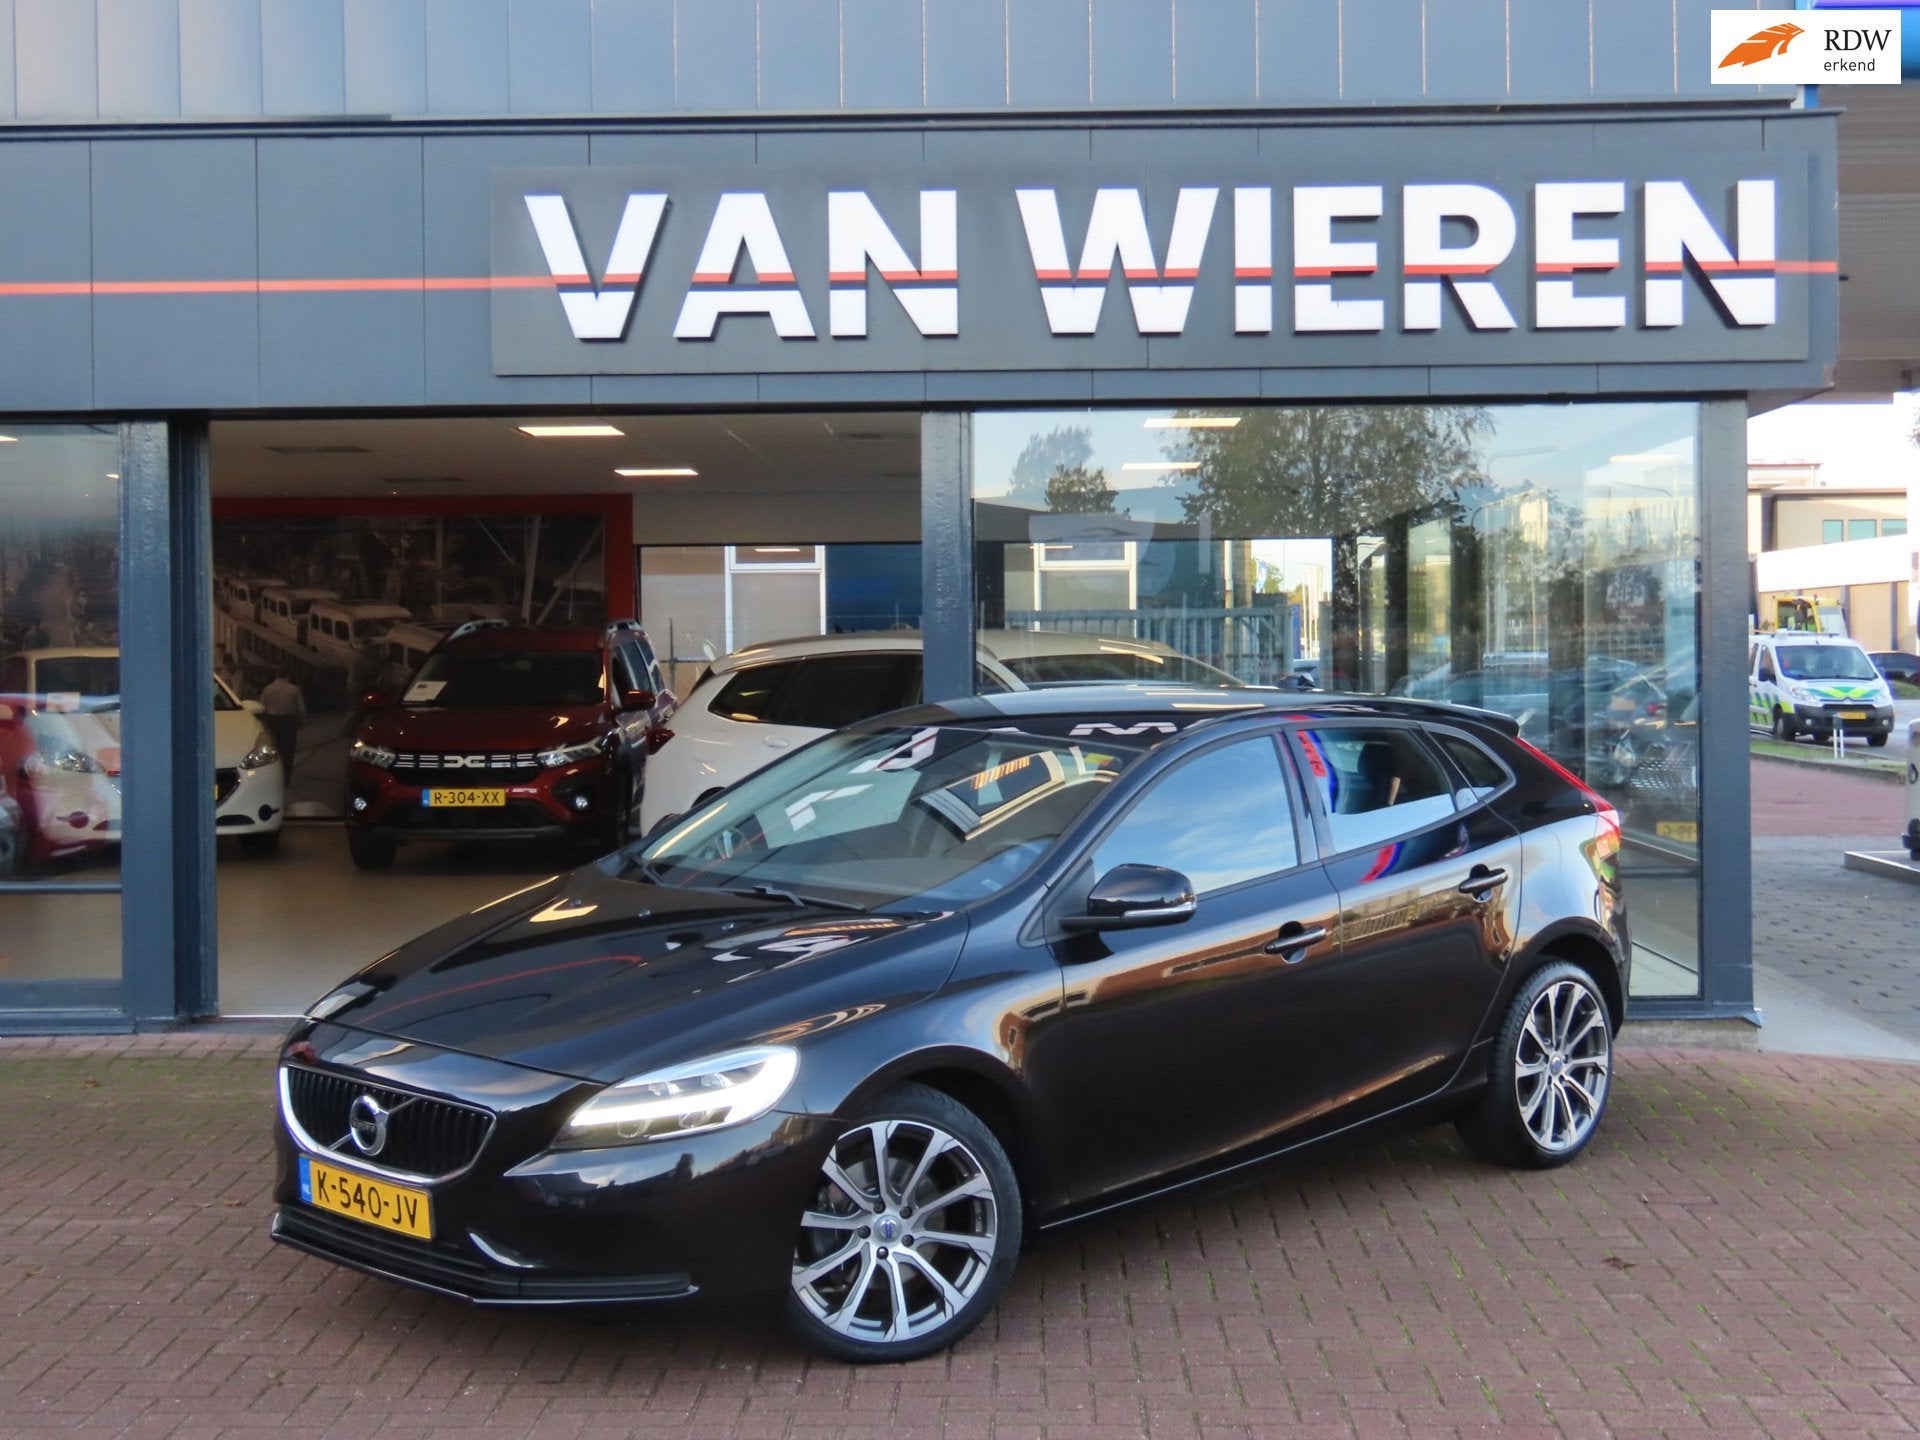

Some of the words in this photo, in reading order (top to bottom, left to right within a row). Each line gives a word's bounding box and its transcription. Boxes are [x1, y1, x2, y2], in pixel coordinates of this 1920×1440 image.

[523, 187, 959, 340] VAN
[1014, 179, 1777, 335] WIEREN
[434, 791, 500, 804] R-304-XX
[317, 1170, 418, 1228] K-540-JV
